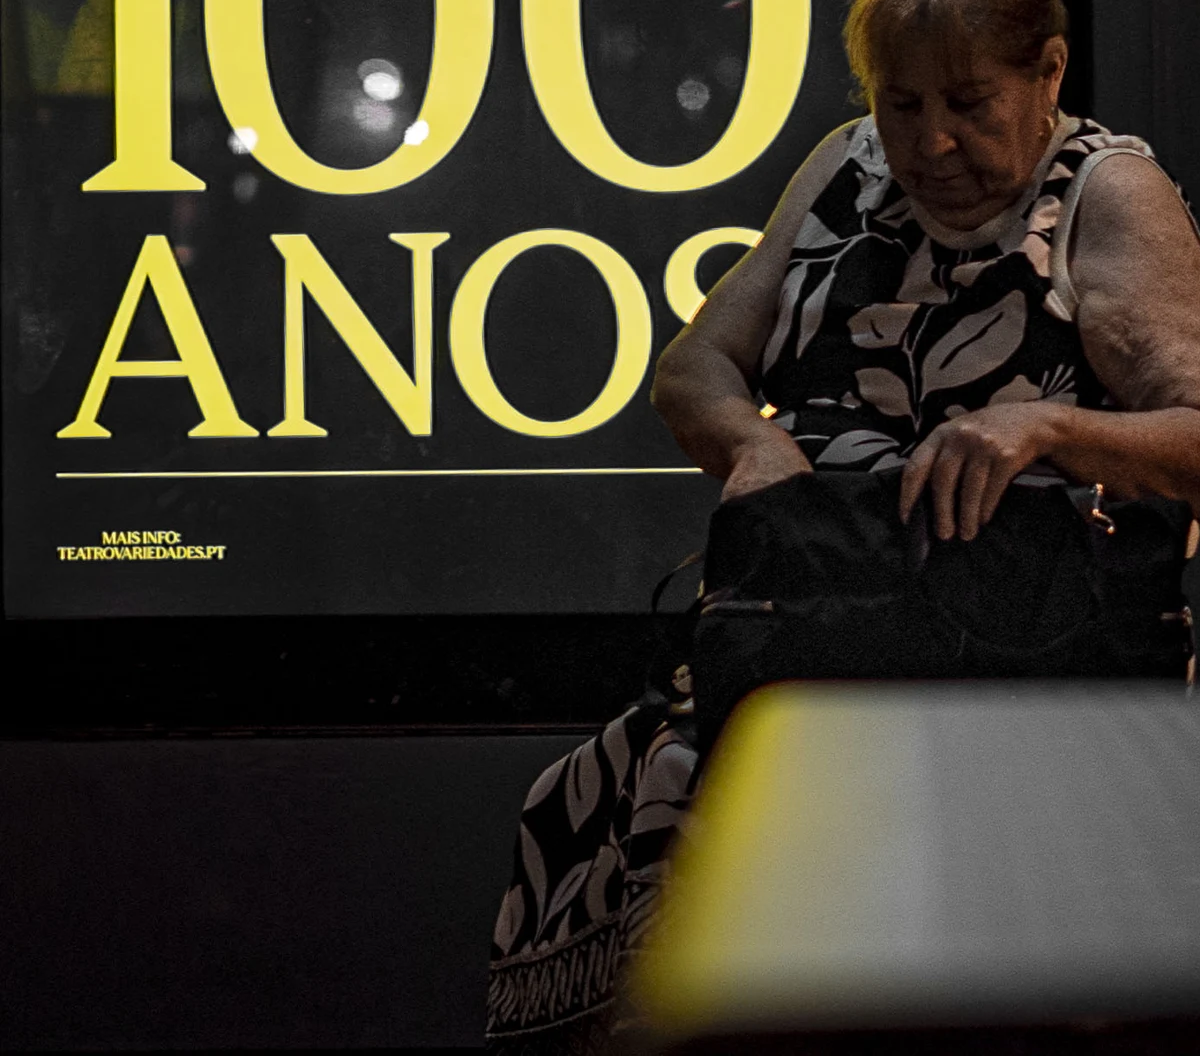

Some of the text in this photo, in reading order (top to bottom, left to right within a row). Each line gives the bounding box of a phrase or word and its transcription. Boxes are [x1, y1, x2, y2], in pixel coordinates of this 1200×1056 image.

[101, 530, 182, 545] MAIS INFO:
[56, 545, 228, 561] TEATROVARIEDADES.PT
